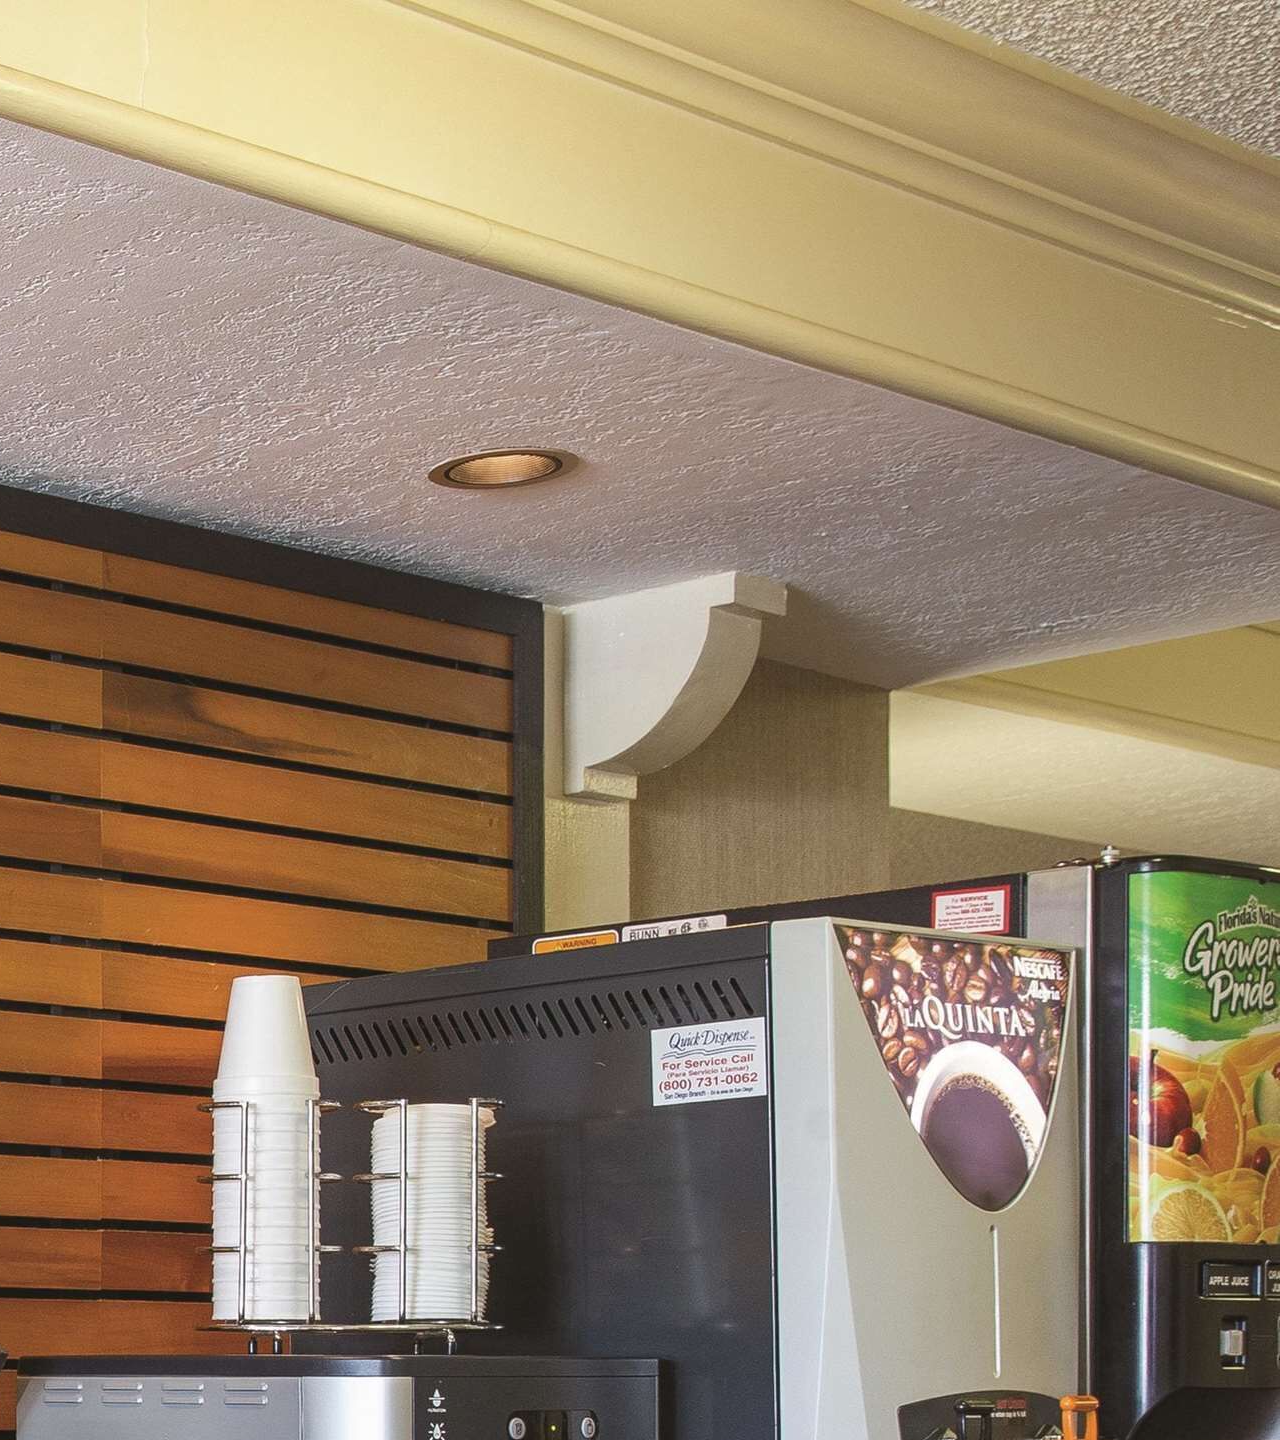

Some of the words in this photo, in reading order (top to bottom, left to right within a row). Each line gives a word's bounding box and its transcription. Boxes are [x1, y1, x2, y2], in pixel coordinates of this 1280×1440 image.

[562, 938, 597, 950] WARNING
[1207, 967, 1275, 1018] Pride
[905, 1007, 925, 1029] LA
[922, 995, 1027, 1040] QUINTA
[669, 1031, 701, 1051] Quick
[701, 1029, 750, 1047] Dispense
[662, 1062, 681, 1071] For
[684, 1057, 728, 1069] Service
[731, 1053, 754, 1063] Call
[659, 1079, 692, 1093] (800)
[696, 1072, 758, 1088] 731-0062
[667, 1071, 686, 1080] (Para
[688, 1068, 719, 1077] Servicio
[689, 1090, 706, 1098] Branch
[1208, 1275, 1230, 1286] APPLE
[1231, 1276, 1250, 1286] JUICE
